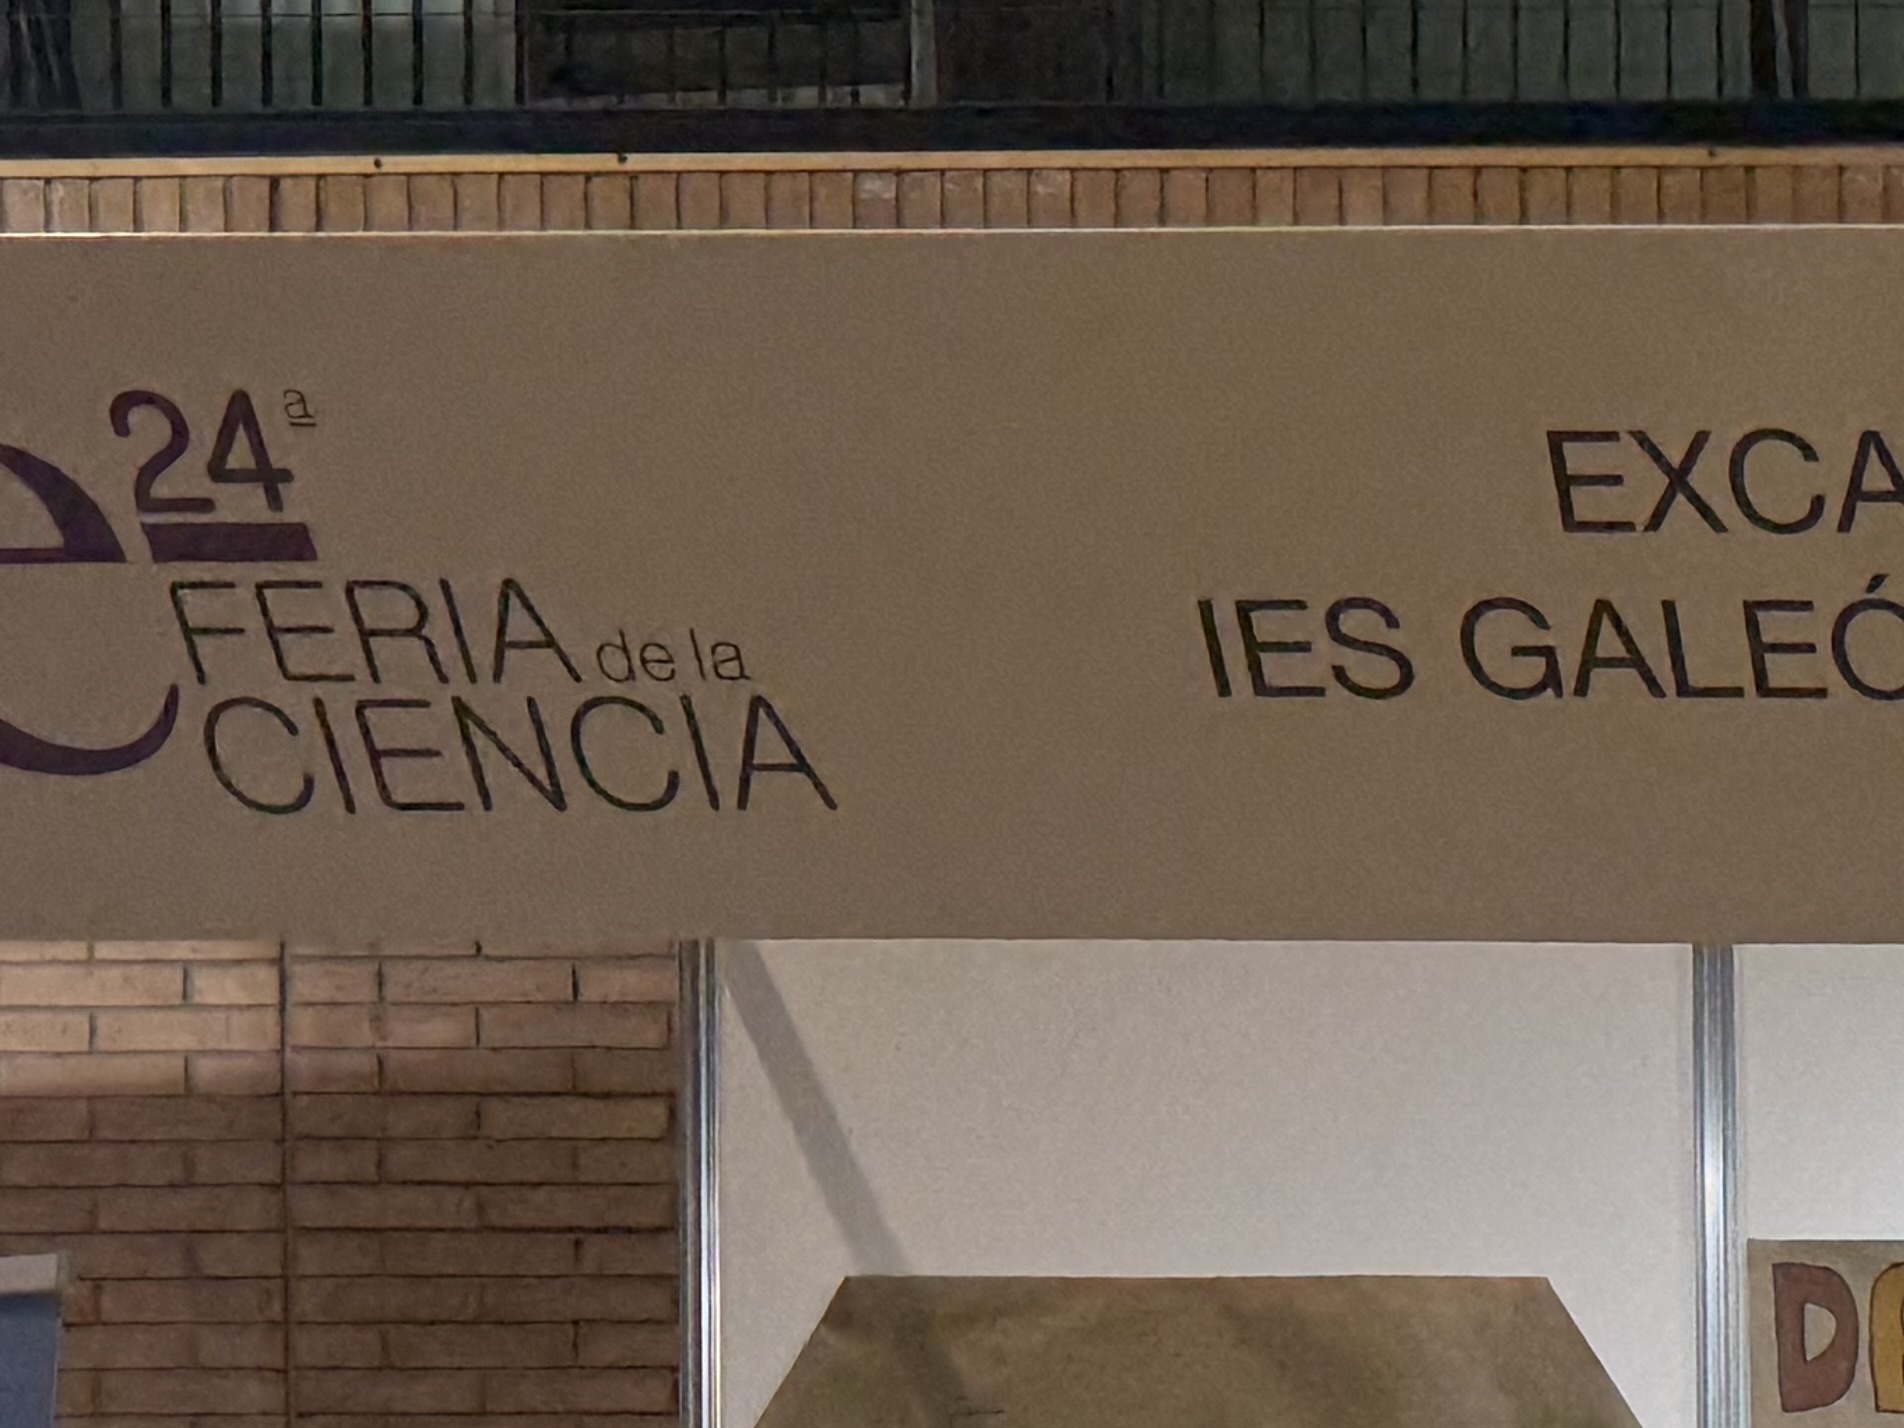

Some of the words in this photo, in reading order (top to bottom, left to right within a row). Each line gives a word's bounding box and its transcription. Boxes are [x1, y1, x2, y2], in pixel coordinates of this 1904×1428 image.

[168, 577, 583, 686] FERIA
[596, 629, 677, 684] de
[692, 628, 753, 682] la
[1198, 597, 1416, 700] IES
[203, 695, 838, 814] CIENCIA
